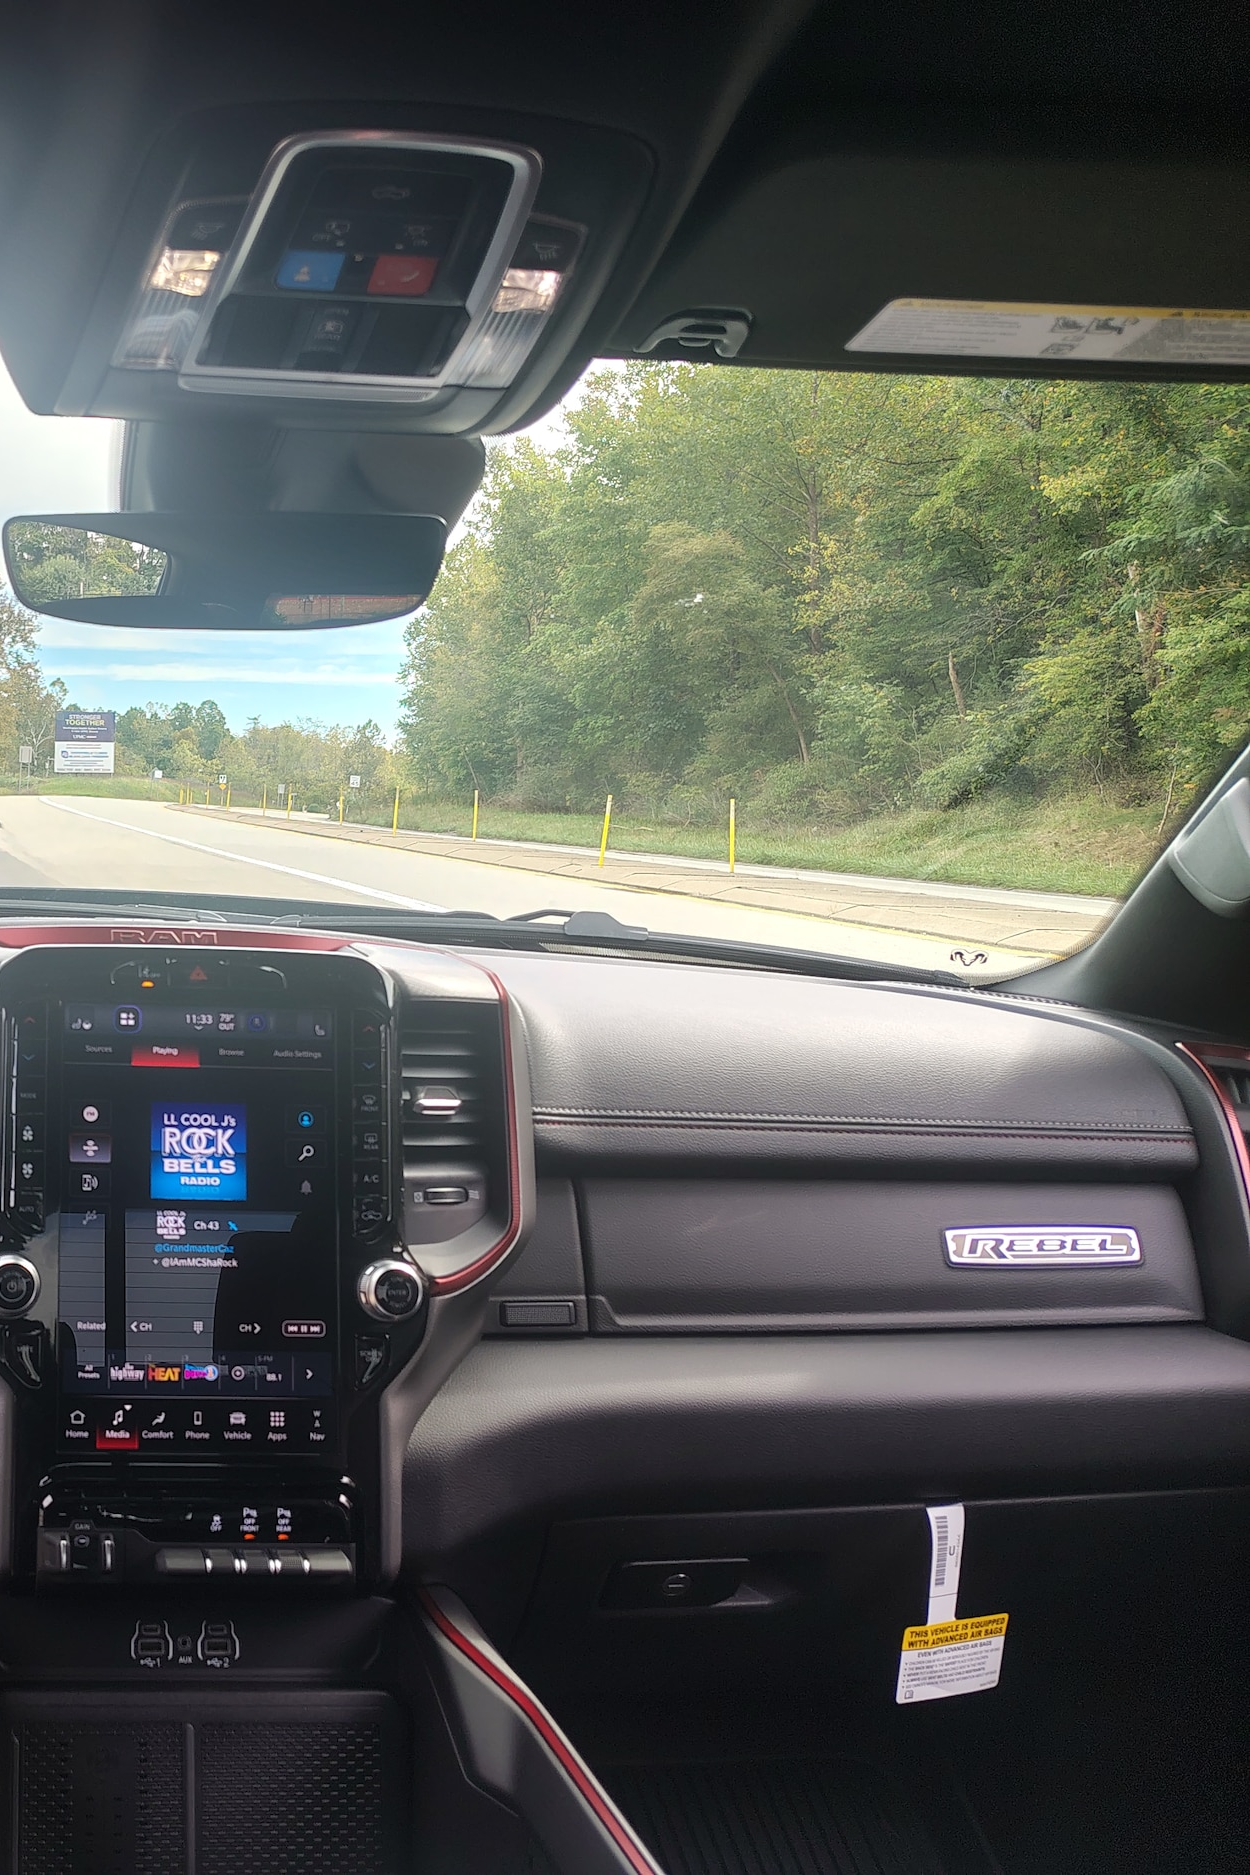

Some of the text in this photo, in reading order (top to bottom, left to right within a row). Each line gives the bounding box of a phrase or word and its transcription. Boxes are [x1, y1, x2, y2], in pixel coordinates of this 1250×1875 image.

[110, 929, 218, 944] RAM
[185, 1013, 214, 1025] 11:33
[218, 1022, 235, 1031] OUT
[85, 1044, 113, 1053] Sources
[152, 1046, 179, 1057] Playing
[218, 1048, 245, 1056] Browse
[273, 1050, 322, 1060] Audio Settings
[163, 1112, 237, 1127] LL COOL J's
[161, 1126, 236, 1157] ROCK
[162, 1158, 237, 1174] BELLS
[180, 1176, 221, 1186] RADIO
[363, 1173, 379, 1184] A/C
[18, 1206, 35, 1214] AUTO
[156, 1216, 186, 1228] ROCK
[193, 1220, 220, 1231] Ch 43
[961, 1234, 1128, 1260] REBEL
[76, 1321, 106, 1331] Related
[139, 1322, 152, 1331] CH
[238, 1323, 252, 1333] CH
[77, 1371, 101, 1379] Presets
[110, 1365, 145, 1381] highway
[147, 1367, 181, 1381] HEAT
[65, 1429, 90, 1439] Home
[105, 1429, 130, 1439] Media
[141, 1429, 174, 1439] Comfort
[185, 1430, 210, 1440] Phone
[223, 1430, 253, 1440] Vehicle
[267, 1431, 288, 1441] Apps
[309, 1432, 326, 1441] Nav
[74, 1522, 90, 1530] GAIN
[210, 1524, 222, 1532] OFF
[239, 1524, 259, 1532] FRONT
[910, 1617, 1006, 1639] THIS VEHICLE IS EQUIPPED
[908, 1626, 1003, 1649] WITH ADVANCED AIR BAGS
[932, 1648, 944, 1656] WITH
[944, 1645, 971, 1654] ADVANCED
[979, 1640, 992, 1648] BAGS
[178, 1655, 193, 1664] AUX
